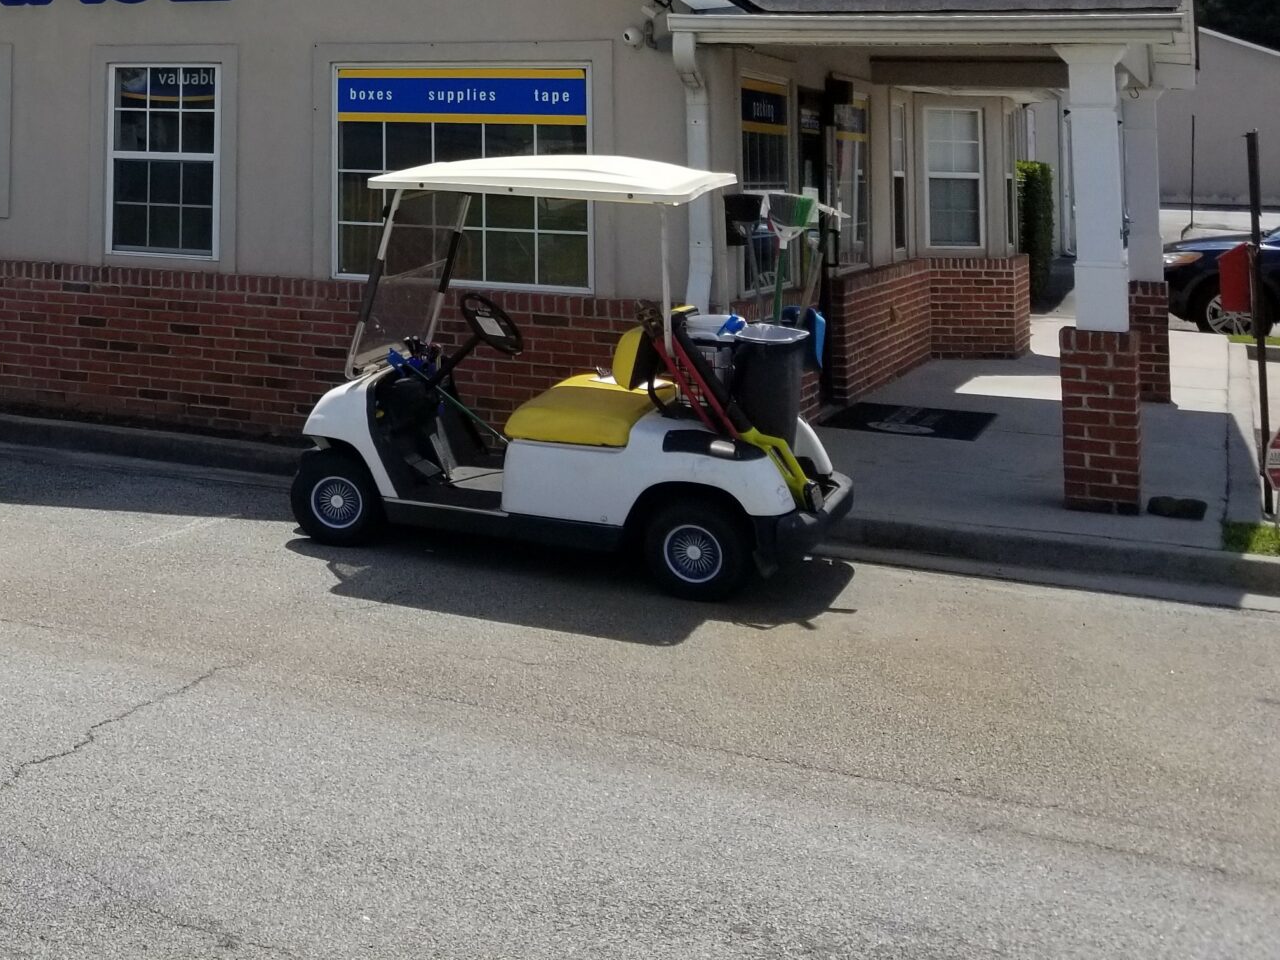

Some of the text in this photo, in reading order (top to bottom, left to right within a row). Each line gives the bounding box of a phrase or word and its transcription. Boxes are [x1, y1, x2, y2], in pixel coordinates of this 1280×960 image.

[158, 68, 215, 85] valuabl
[349, 88, 570, 105] boxes supplies tape
